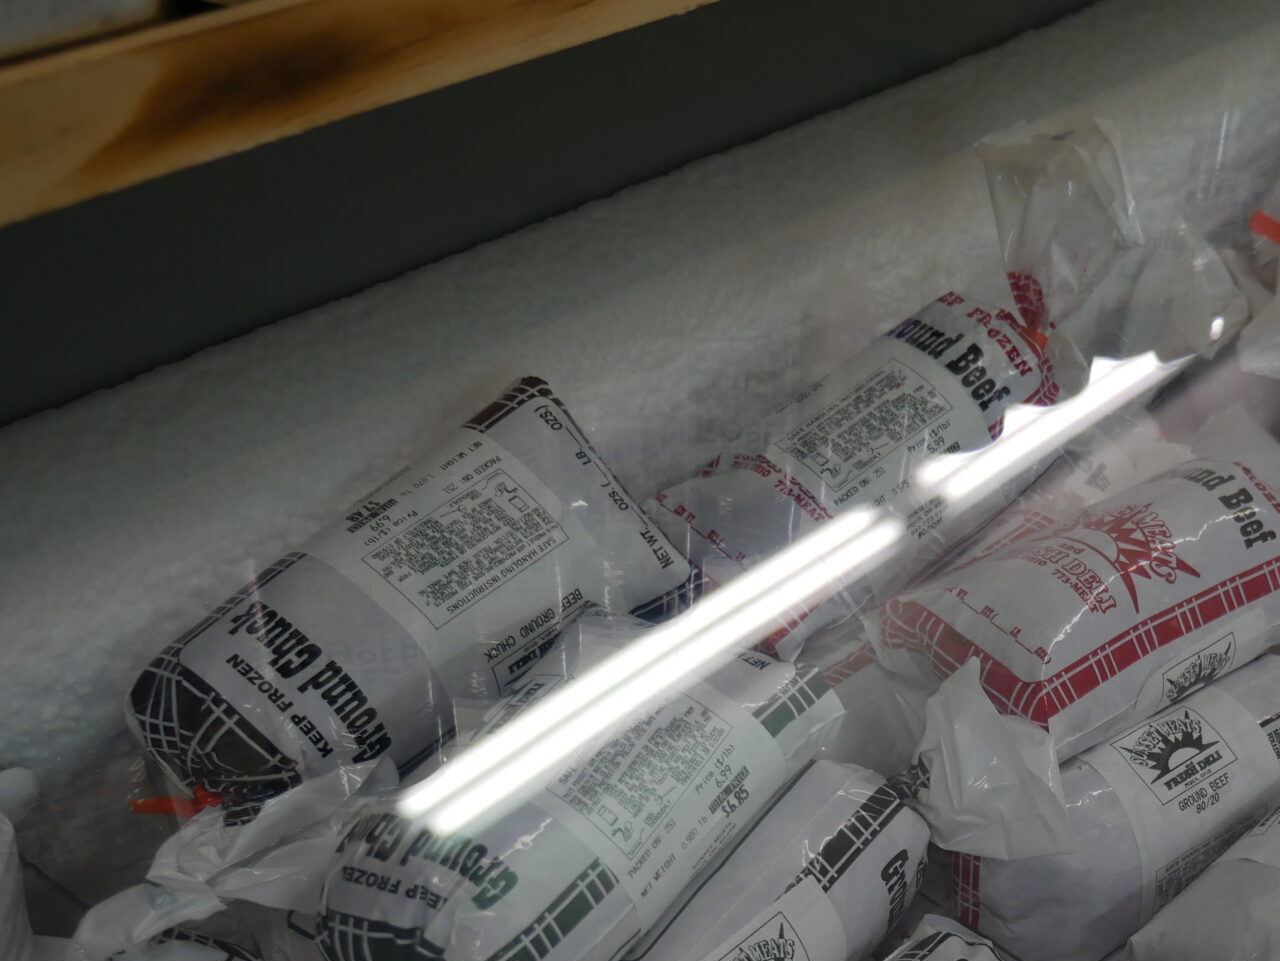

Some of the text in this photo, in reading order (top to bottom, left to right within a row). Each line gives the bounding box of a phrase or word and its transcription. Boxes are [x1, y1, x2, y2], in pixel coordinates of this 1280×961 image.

[966, 305, 1032, 377] FROZEN
[947, 345, 1009, 408] Beef
[470, 452, 502, 477] PACKED
[925, 434, 947, 454] 5.99
[637, 524, 659, 548] WT.
[1219, 488, 1278, 549] Beef
[443, 534, 556, 615] SAFE HANDLING INSTRUCTIONS
[651, 544, 674, 570] NET
[1061, 554, 1117, 613] DELI
[481, 586, 585, 662] BEEF GROUND CHUCK
[228, 600, 392, 765] Ground Chuck
[224, 649, 338, 759] KEEP FROZEN
[1120, 704, 1205, 772] SUNSET MEATS
[709, 763, 737, 790] 6.99
[1195, 748, 1223, 771] DELI
[716, 785, 754, 819] $6.85
[1176, 771, 1232, 812] GROUND BEEF
[1192, 791, 1222, 815] 80/20
[622, 846, 657, 878] PACKED
